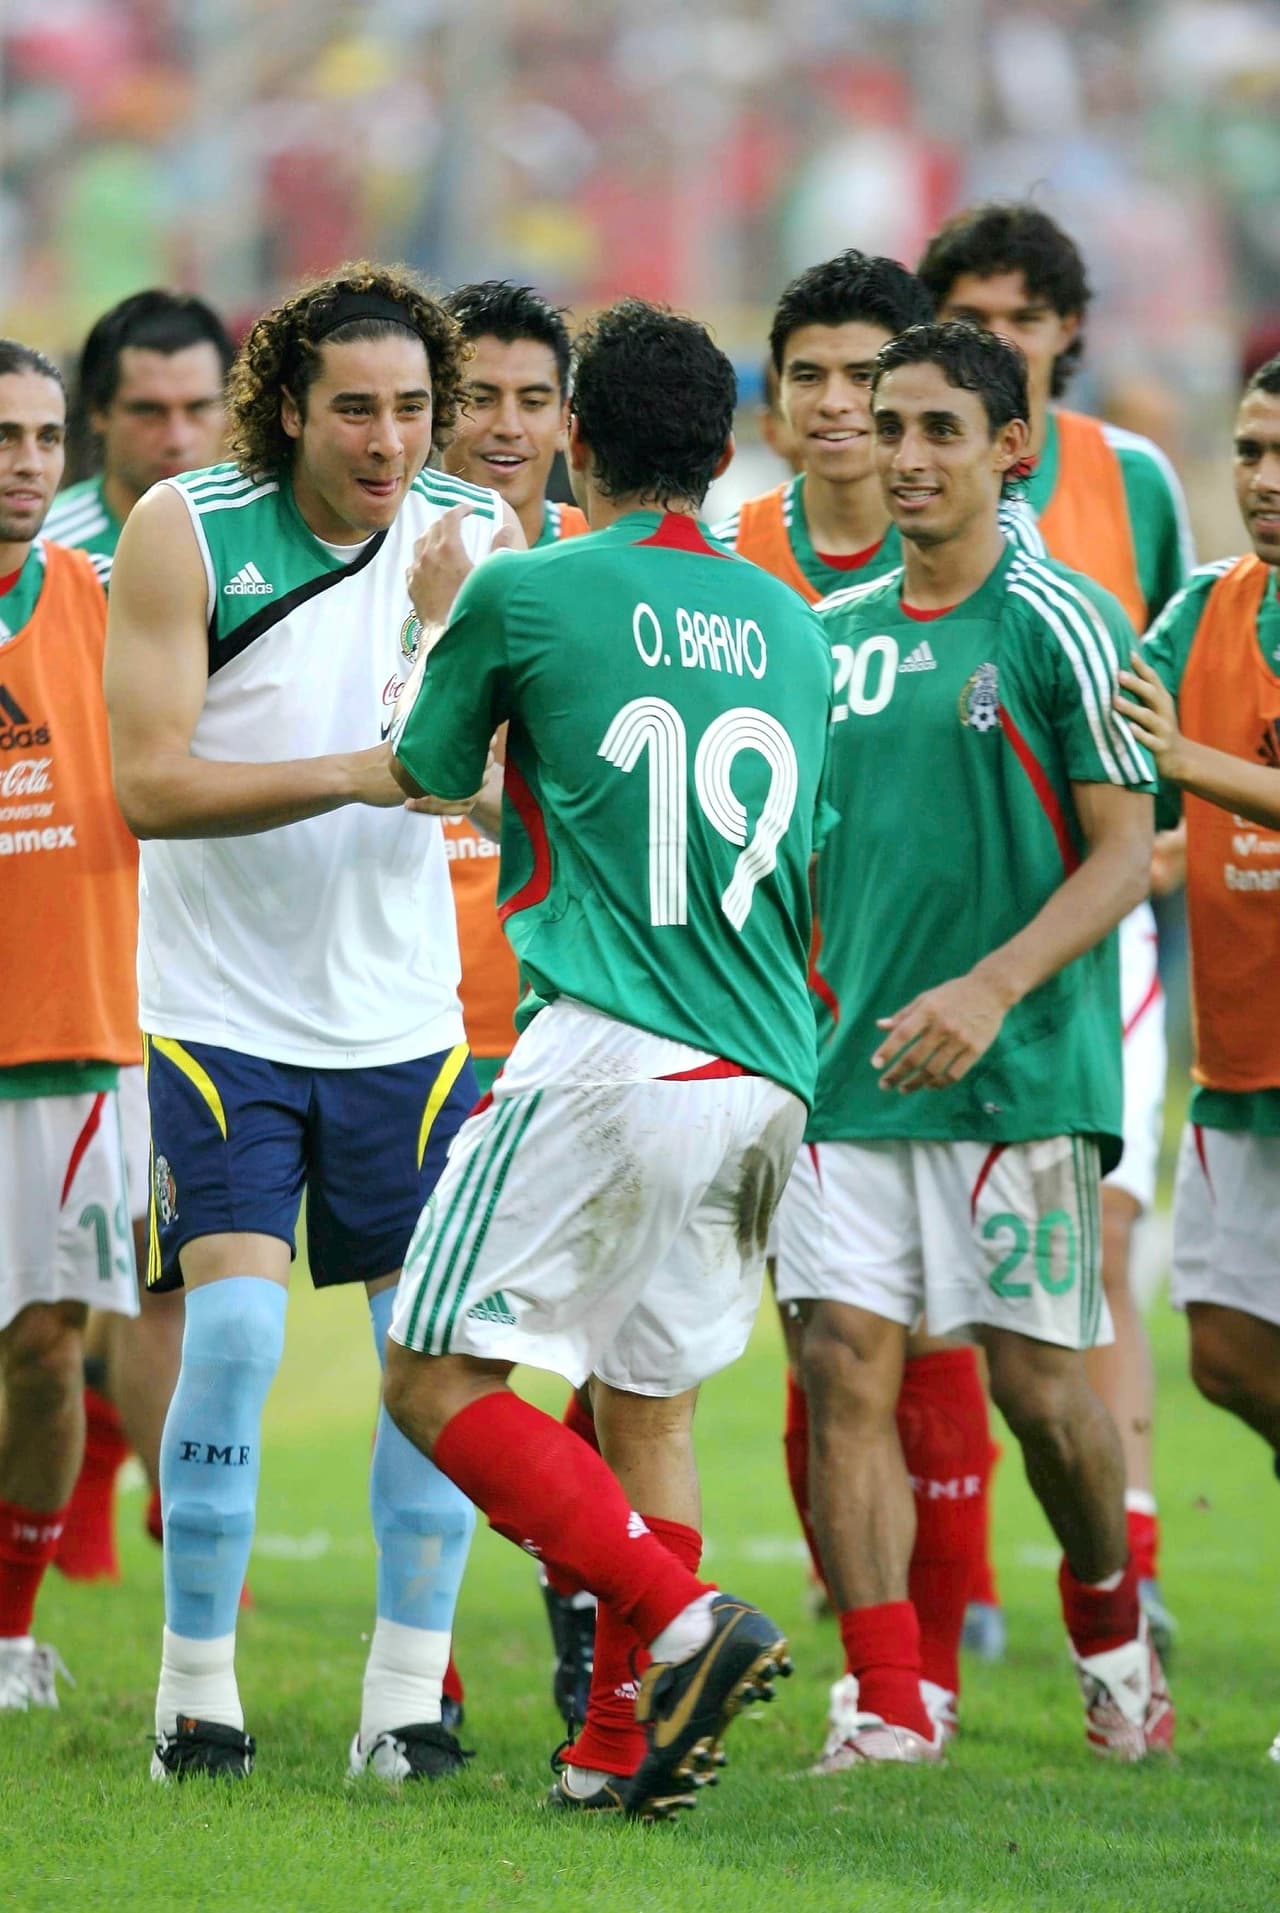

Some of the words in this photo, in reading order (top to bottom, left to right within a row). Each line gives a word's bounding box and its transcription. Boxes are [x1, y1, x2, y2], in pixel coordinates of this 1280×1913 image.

[223, 582, 274, 595] adidas
[632, 602, 672, 667] O.
[676, 607, 767, 679] BRAVO
[830, 634, 899, 724] 20
[0, 757, 53, 798] Cola
[597, 696, 798, 932] 19
[445, 837, 501, 860] ana
[982, 1208, 1077, 1297] 20
